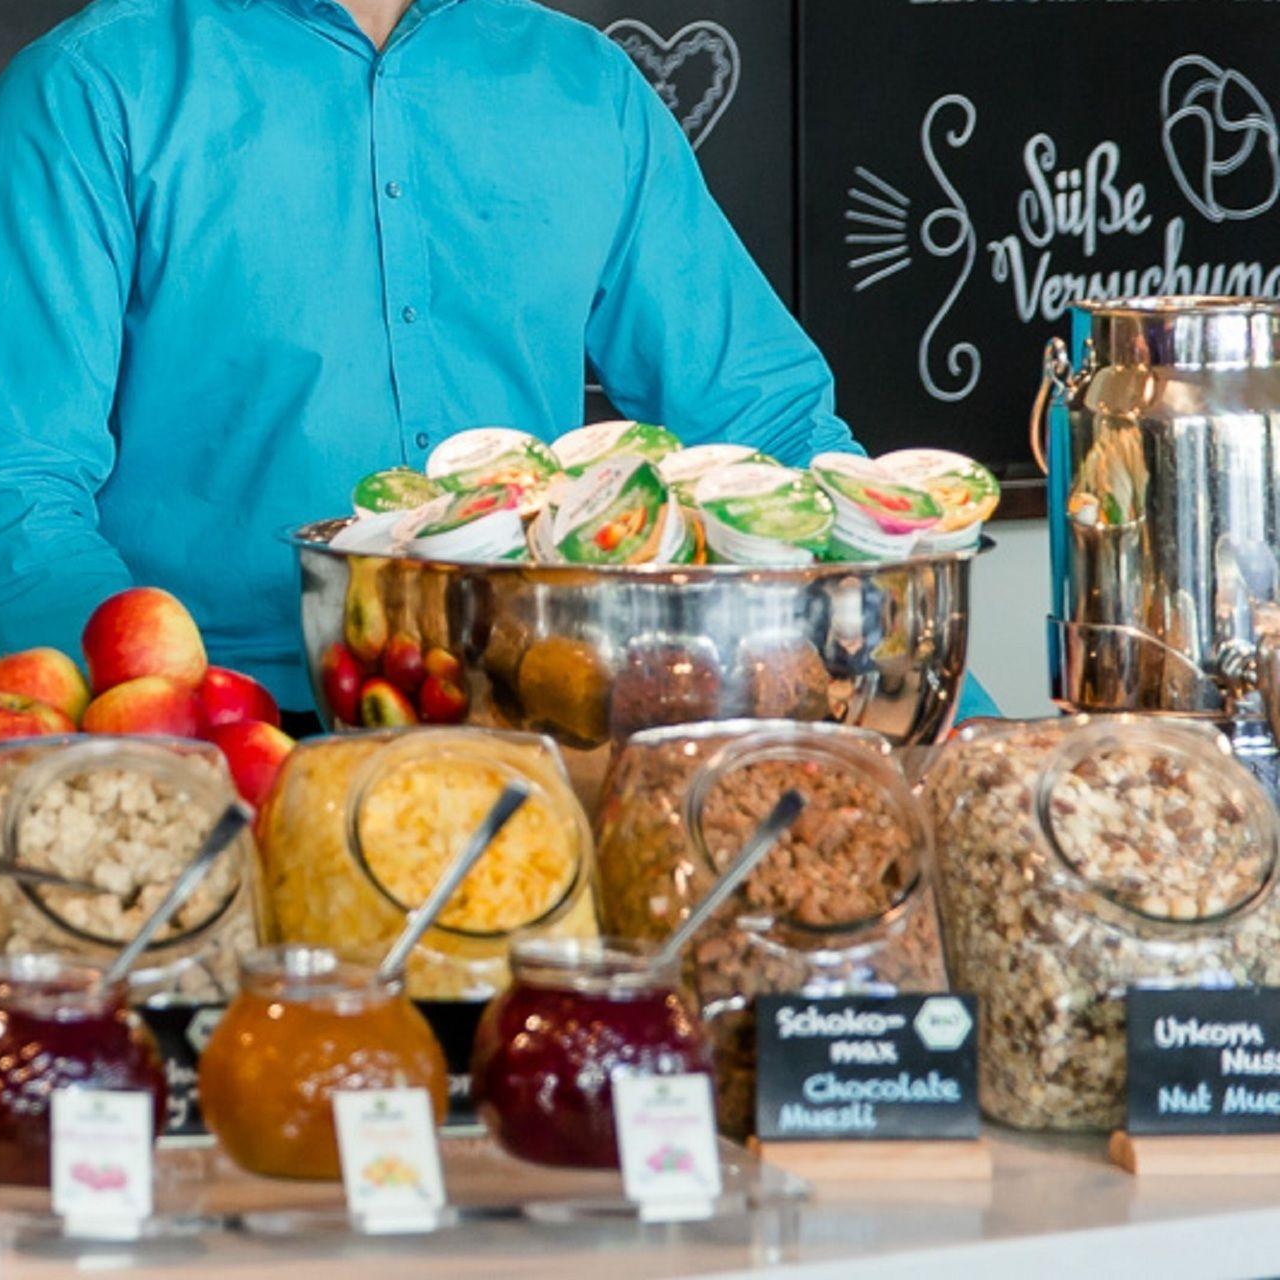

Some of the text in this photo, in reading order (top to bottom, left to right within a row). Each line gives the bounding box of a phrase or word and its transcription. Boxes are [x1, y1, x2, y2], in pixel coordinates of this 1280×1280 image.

[1018, 133, 1153, 257] Süße
[1221, 1047, 1280, 1076] Nus
[802, 1071, 962, 1104] Chocolate
[1158, 1081, 1212, 1115] Nut
